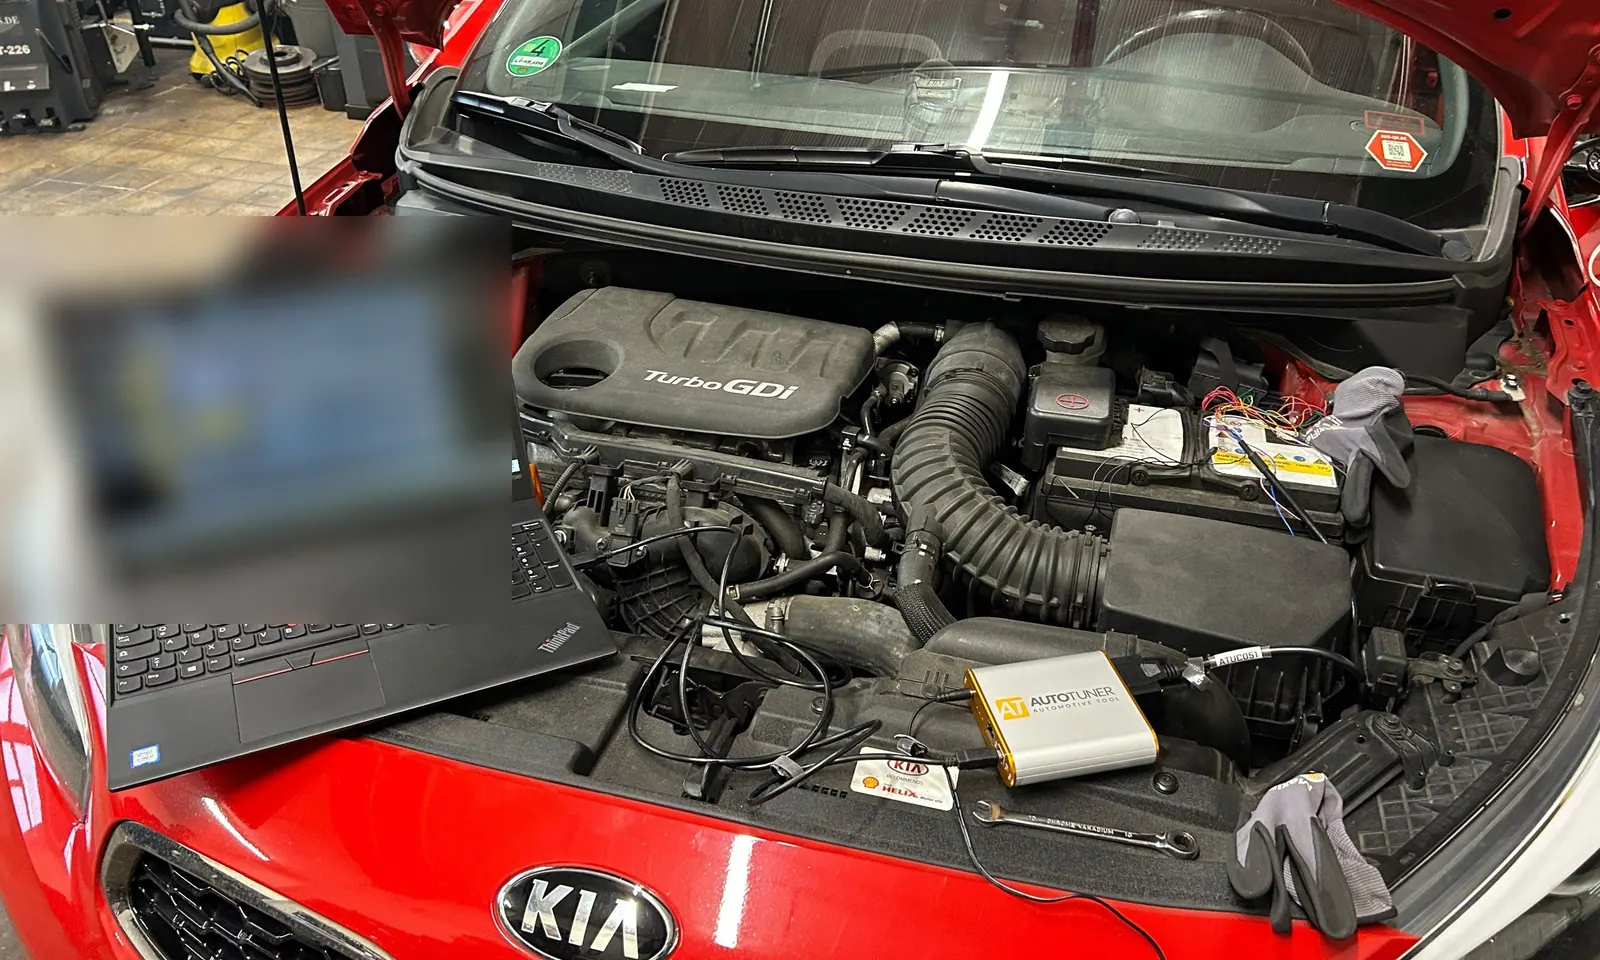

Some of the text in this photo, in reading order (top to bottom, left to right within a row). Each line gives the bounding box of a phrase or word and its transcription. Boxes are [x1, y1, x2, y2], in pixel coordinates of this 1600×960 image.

[530, 39, 551, 57] 4
[643, 369, 800, 400] TurboGDi
[537, 622, 581, 653] ThinkPad
[1030, 686, 1116, 707] AUTOTUNER
[1033, 701, 1093, 713] AUTOMOTIVE
[893, 760, 922, 774] KIA
[882, 785, 918, 799] HELIX
[520, 878, 640, 960] KIA
